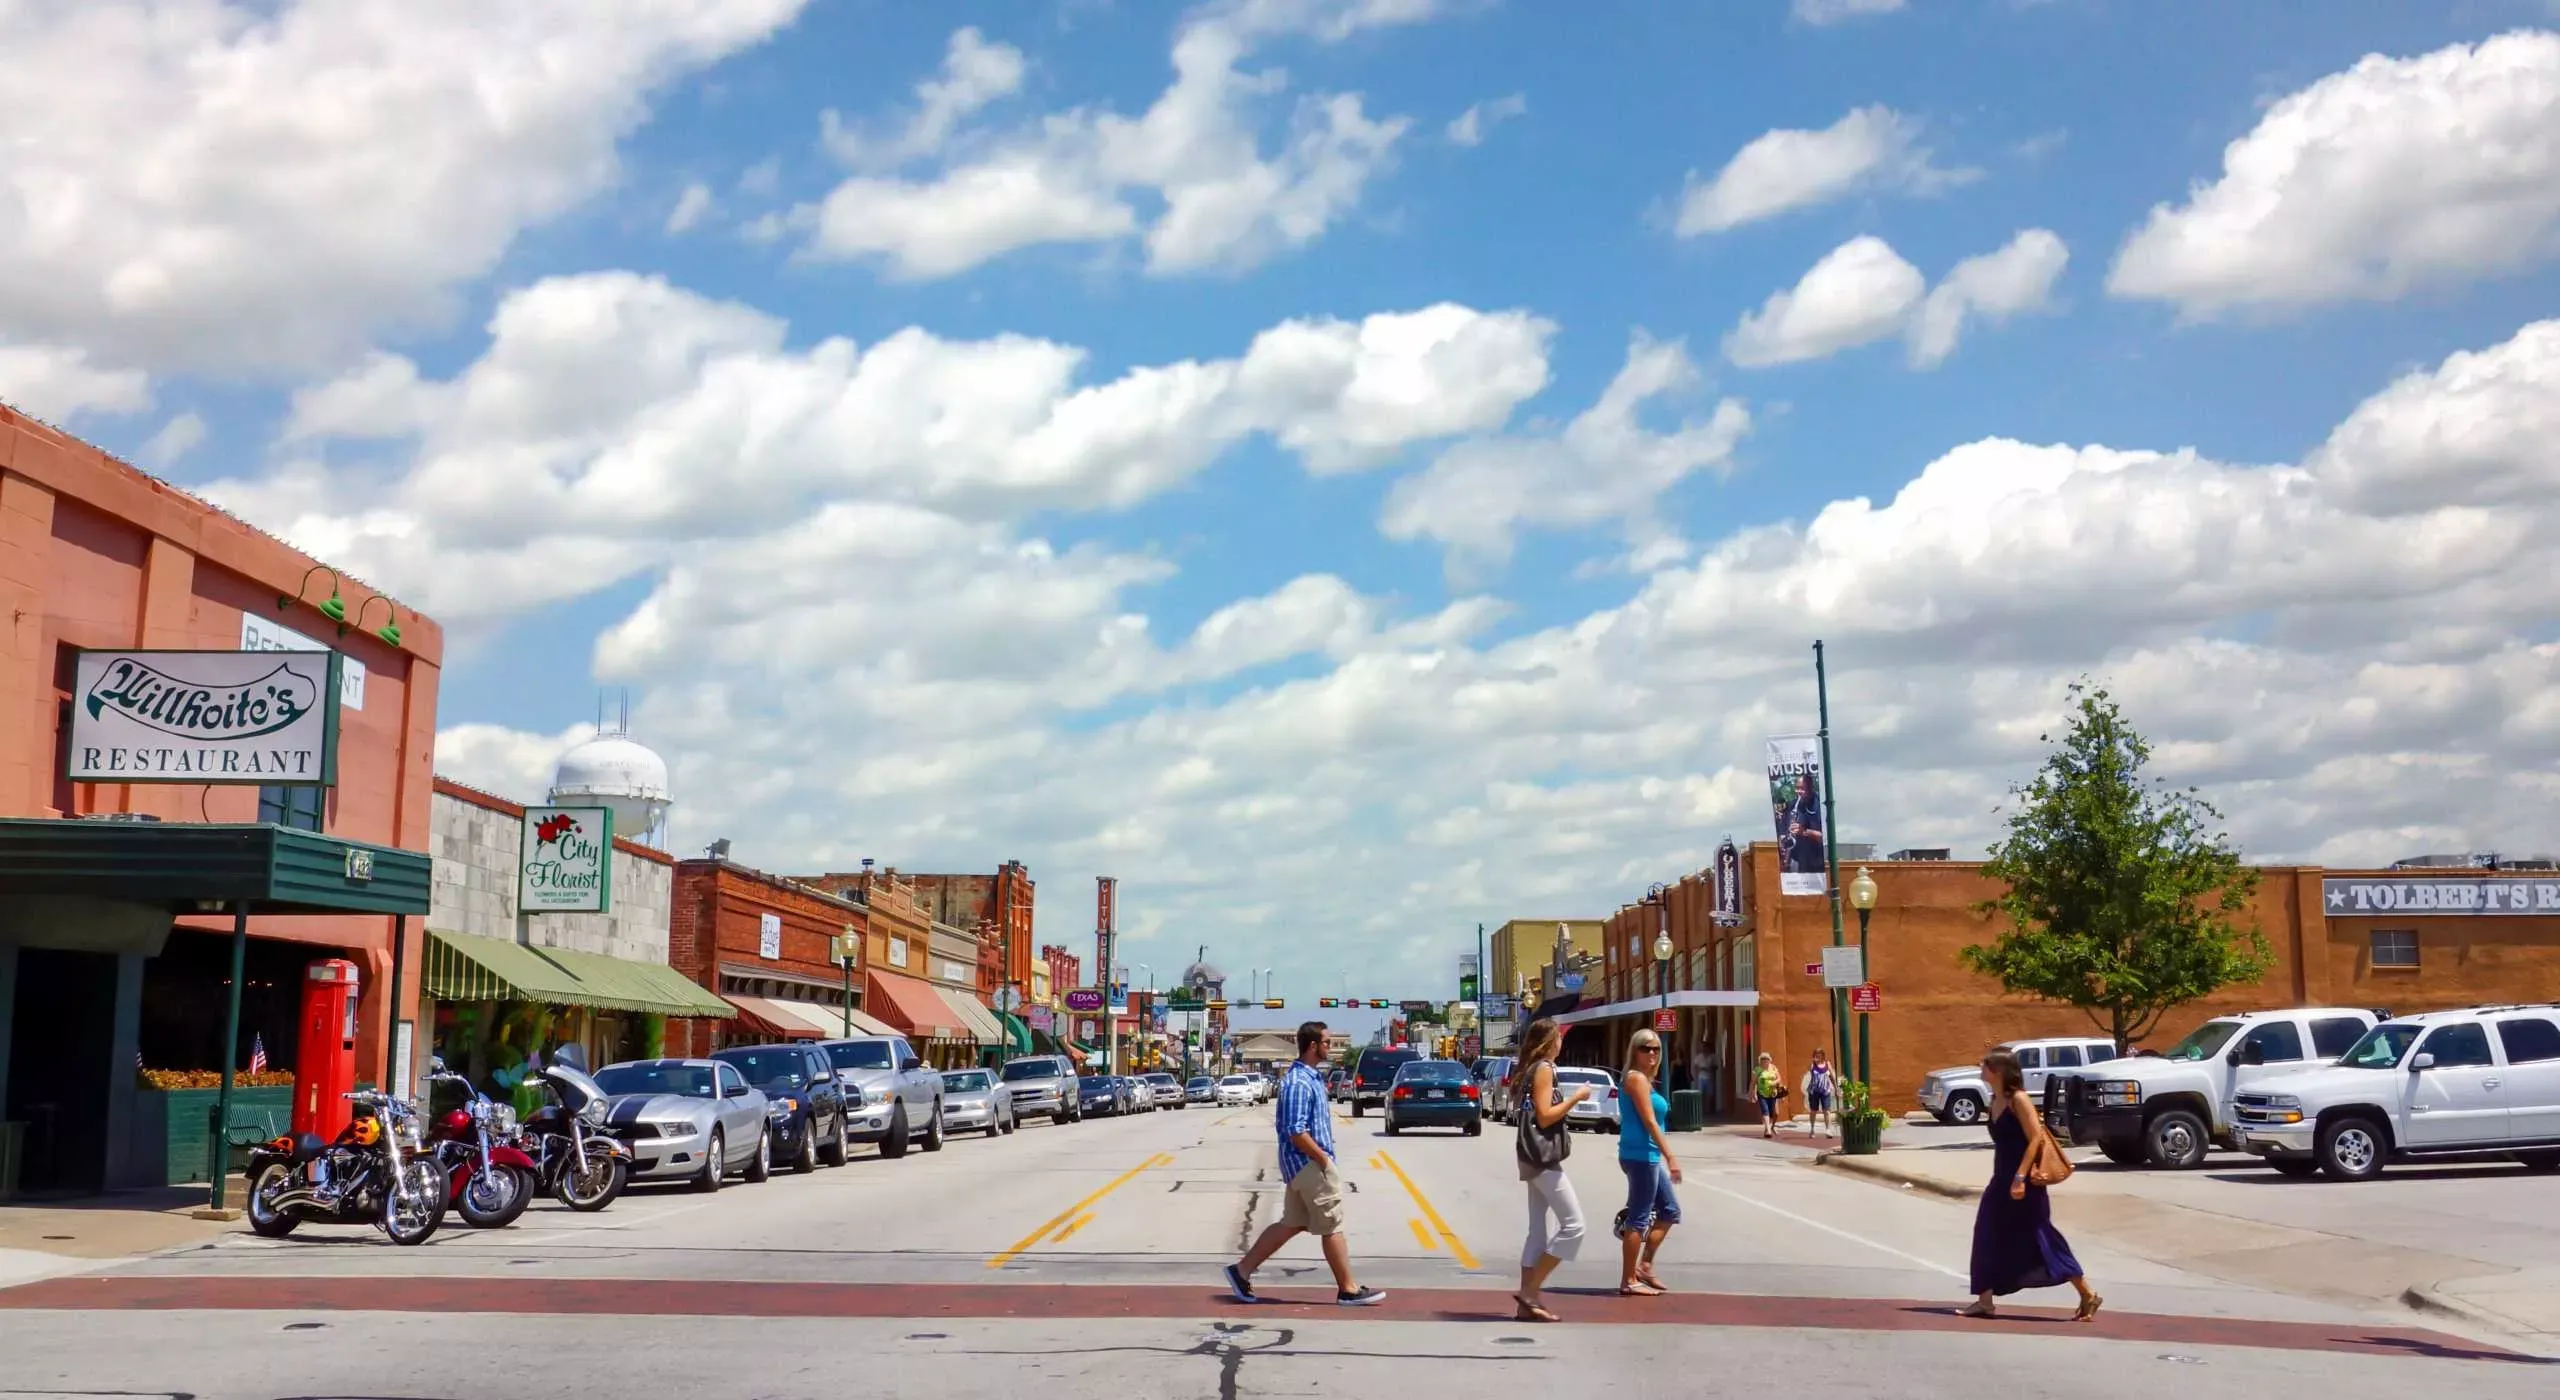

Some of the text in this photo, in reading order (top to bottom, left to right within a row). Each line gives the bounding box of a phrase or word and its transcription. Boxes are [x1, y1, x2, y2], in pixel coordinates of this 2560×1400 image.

[100, 663, 294, 729] Willhoite's
[82, 747, 312, 774] RESTAURANT
[1768, 762, 1818, 777] MUSIC
[560, 833, 598, 867] City
[525, 861, 600, 889] Florist
[2350, 884, 2560, 909] TOLBERT'S R
[1072, 992, 1098, 1002] TEXAS
